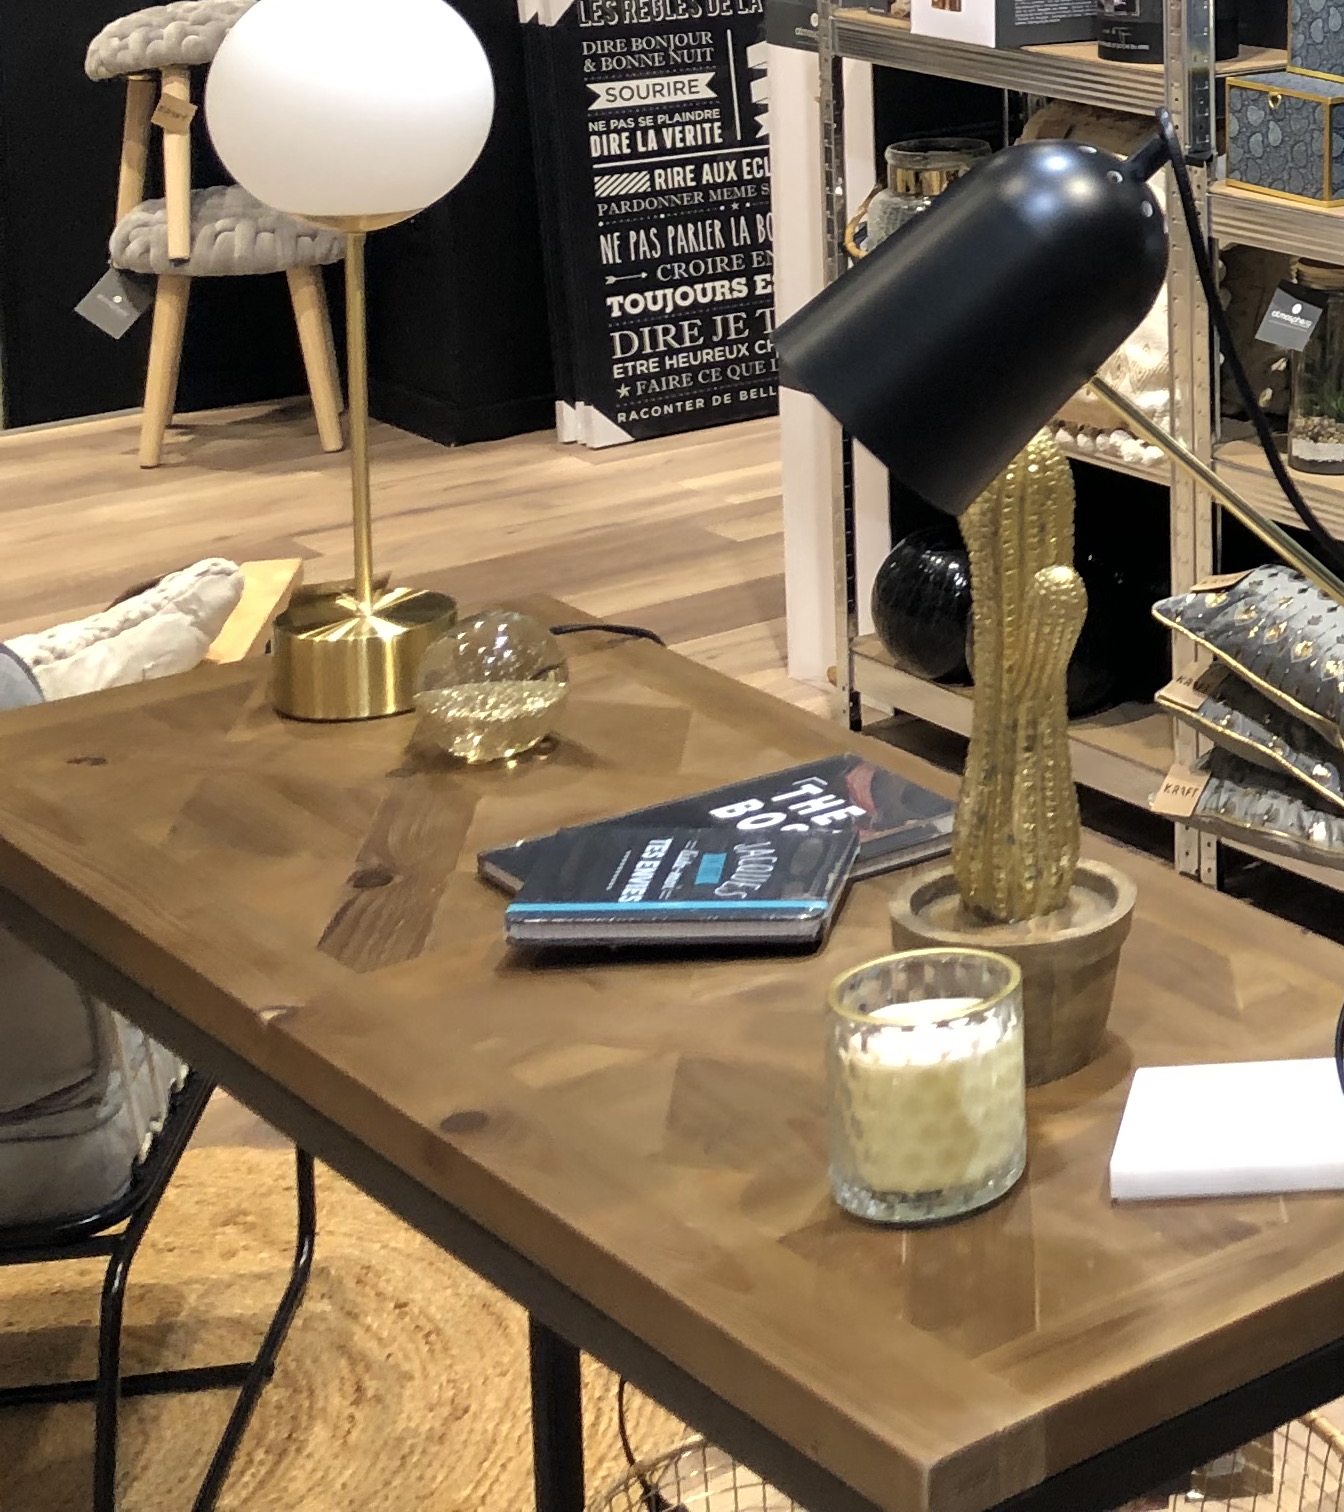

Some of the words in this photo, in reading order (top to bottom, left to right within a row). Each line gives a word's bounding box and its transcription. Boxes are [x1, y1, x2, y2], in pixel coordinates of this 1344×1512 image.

[581, 38, 627, 56] DIRE
[631, 31, 714, 52] BONJOUR
[583, 58, 596, 73] &
[601, 52, 666, 72] BONNE
[669, 47, 715, 65] NUIT
[604, 78, 700, 103] SOURIRE
[588, 120, 607, 132] NE
[610, 118, 635, 130] PAS
[638, 116, 654, 128] SE
[657, 108, 720, 124] PLAINDRE
[590, 132, 632, 158] DIRE
[636, 128, 659, 152] LA
[662, 122, 723, 149] VERITE
[653, 164, 697, 191] RIRE
[702, 160, 738, 185] AUX
[741, 156, 772, 180] ECL
[596, 191, 704, 217] PARDONNER
[708, 184, 758, 202] MEME
[599, 232, 622, 265] NE
[628, 227, 662, 261] PAS
[666, 218, 726, 256] PARLER
[730, 215, 751, 247] LA
[656, 252, 746, 282] CROIRE
[606, 276, 748, 318] TOUJOURS
[610, 319, 704, 359] DIRE
[712, 312, 750, 342] JE
[612, 358, 661, 379] ETRE
[665, 342, 750, 370] HEUREUX
[636, 372, 694, 396] FAIRE
[697, 367, 723, 384] CE
[726, 360, 766, 381] QUE
[616, 398, 705, 423] RACONTER
[711, 393, 732, 406] DE
[739, 386, 777, 401] BELL
[770, 784, 867, 826] THE
[1164, 782, 1198, 798] KRAFT
[642, 836, 674, 858] TES
[618, 860, 662, 902] ENVIES
